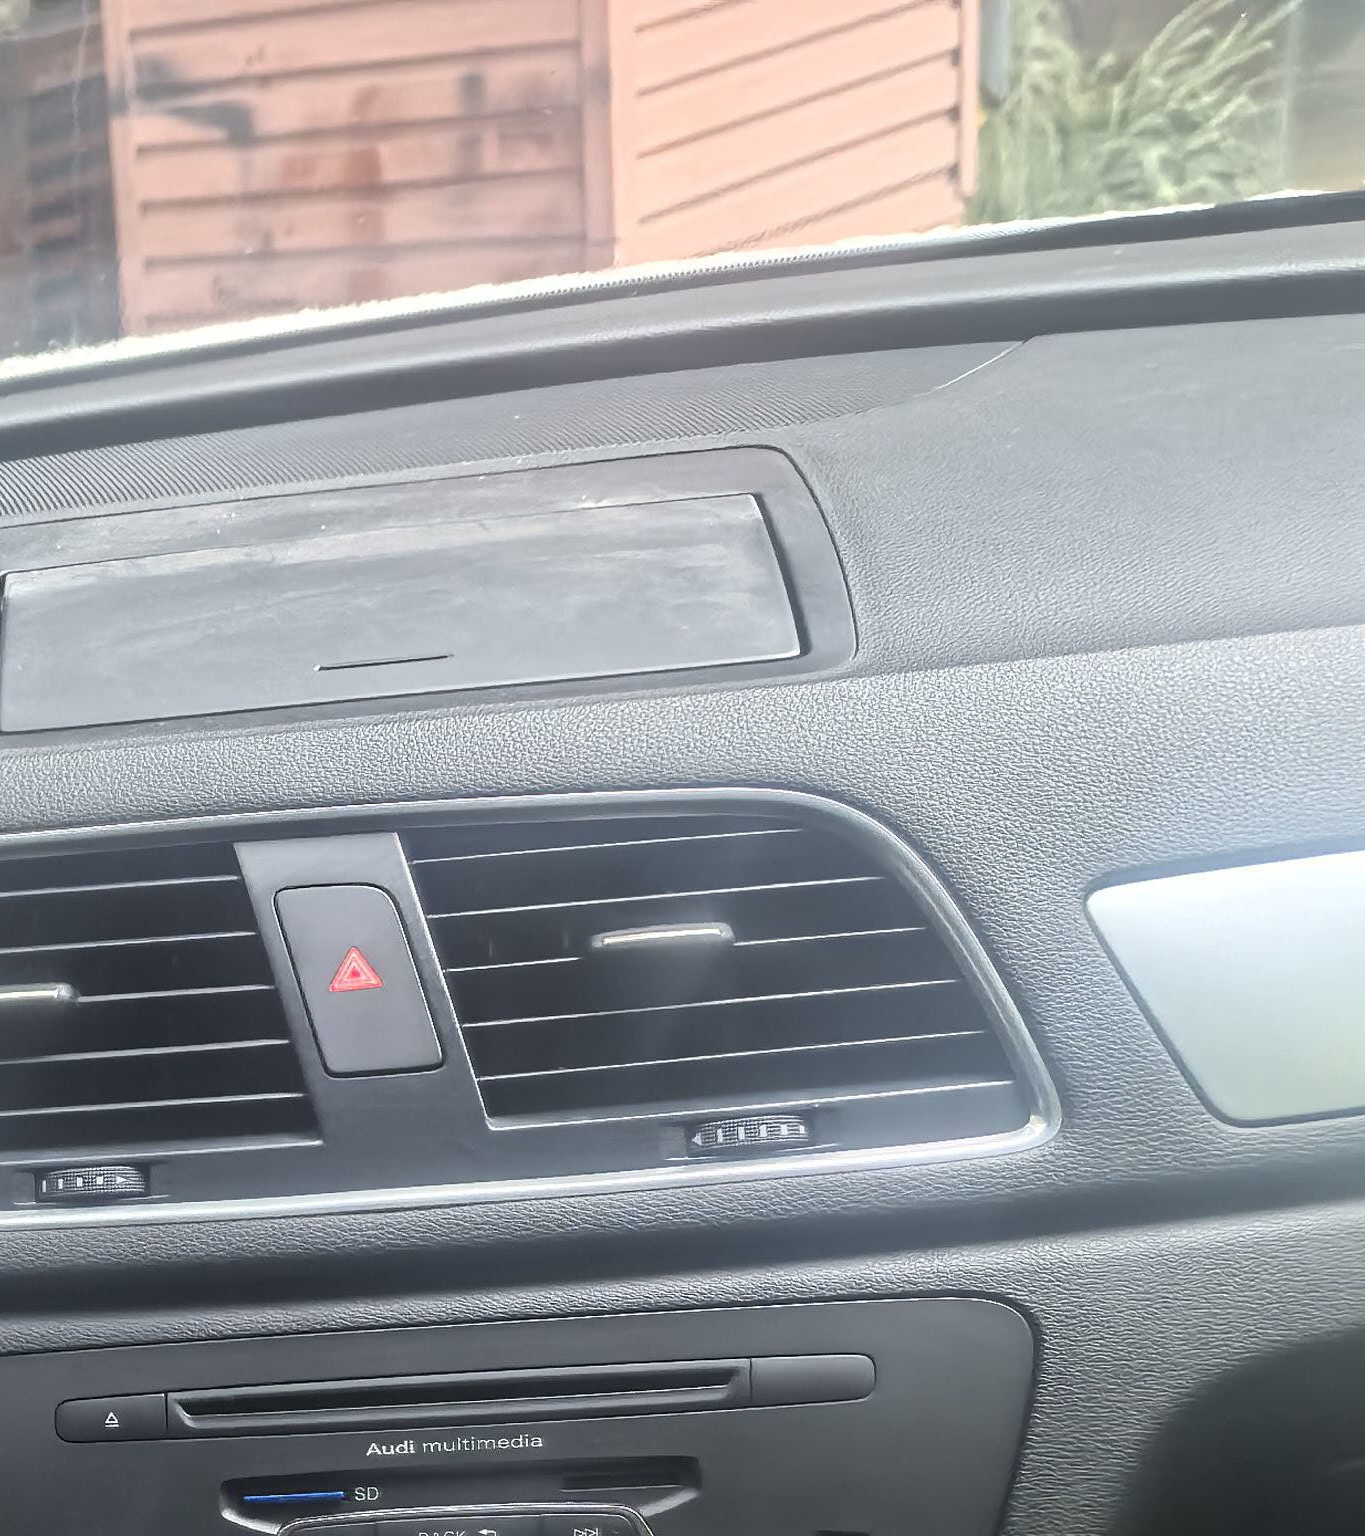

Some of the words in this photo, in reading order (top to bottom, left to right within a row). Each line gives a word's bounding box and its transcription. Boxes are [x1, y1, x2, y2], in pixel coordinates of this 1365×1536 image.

[366, 1440, 416, 1456] Audi
[423, 1434, 543, 1453] multimedia
[354, 1486, 379, 1501] SD
